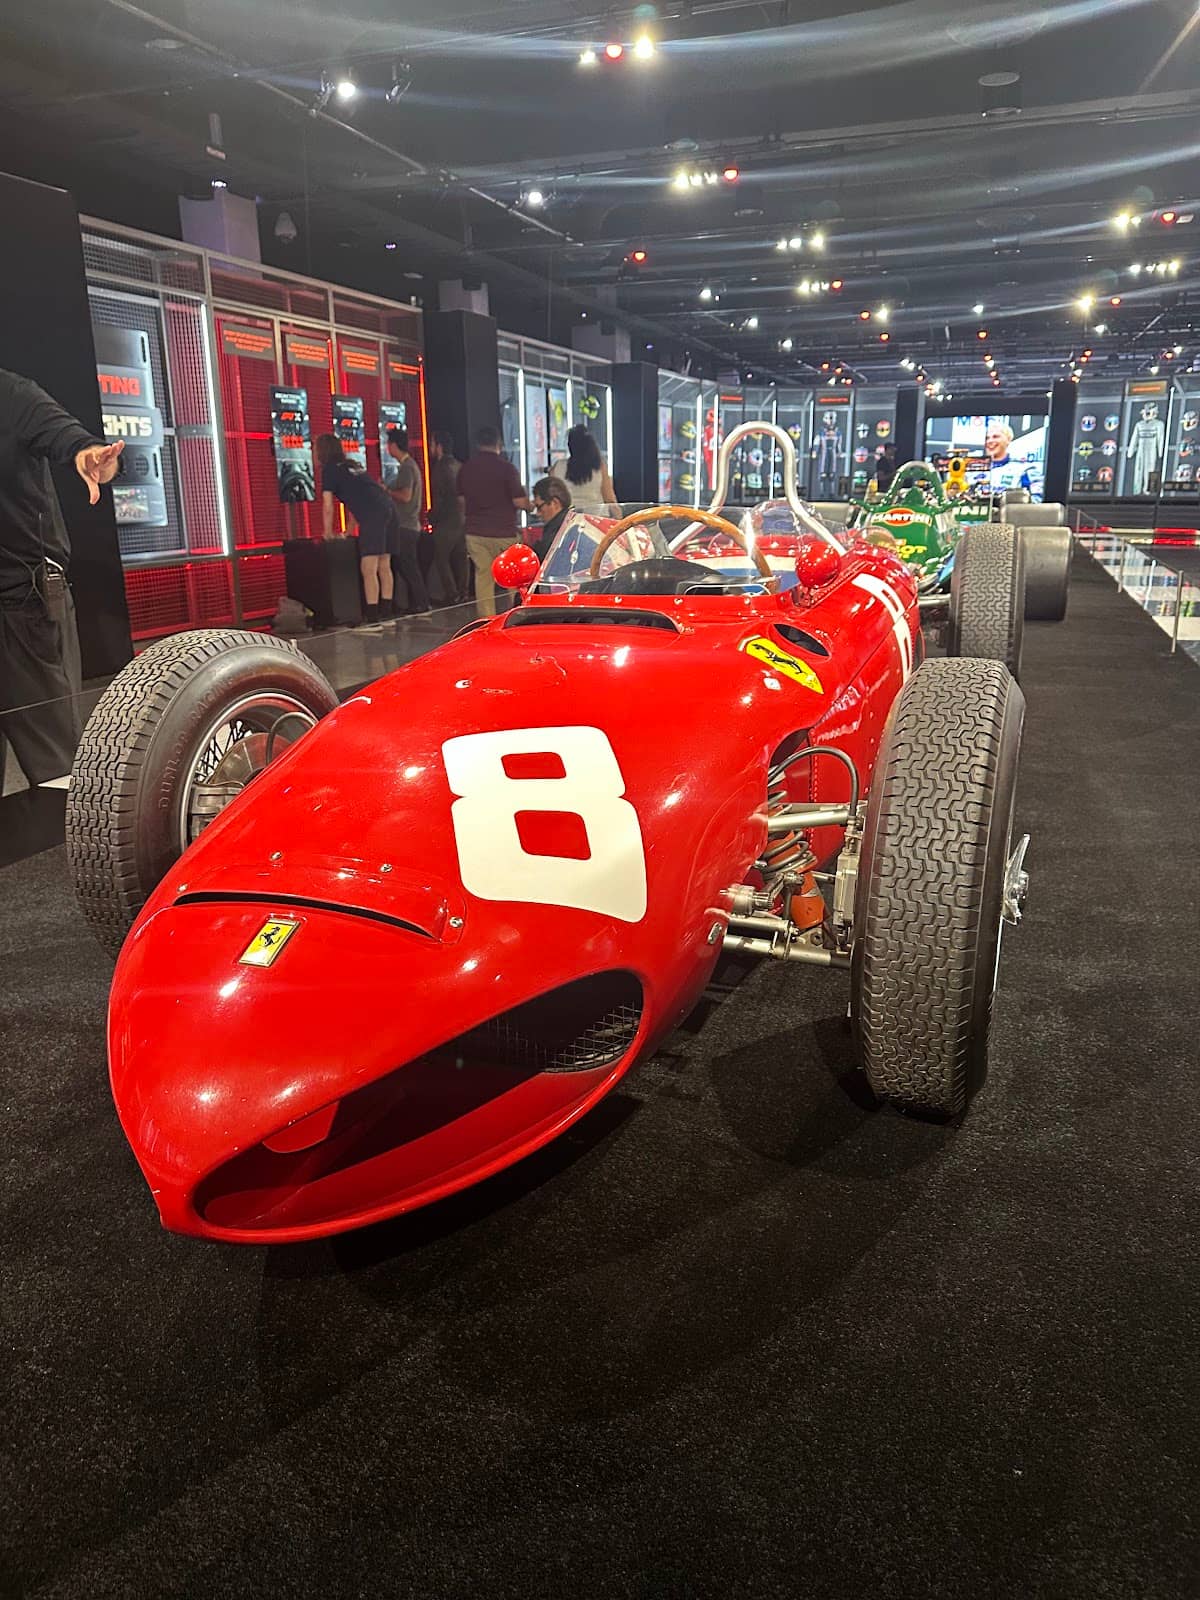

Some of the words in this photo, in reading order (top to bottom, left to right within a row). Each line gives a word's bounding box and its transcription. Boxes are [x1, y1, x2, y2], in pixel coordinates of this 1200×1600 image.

[871, 511, 933, 527] MARTINI
[158, 731, 190, 809] DUNLOP
[441, 725, 648, 924] 8
